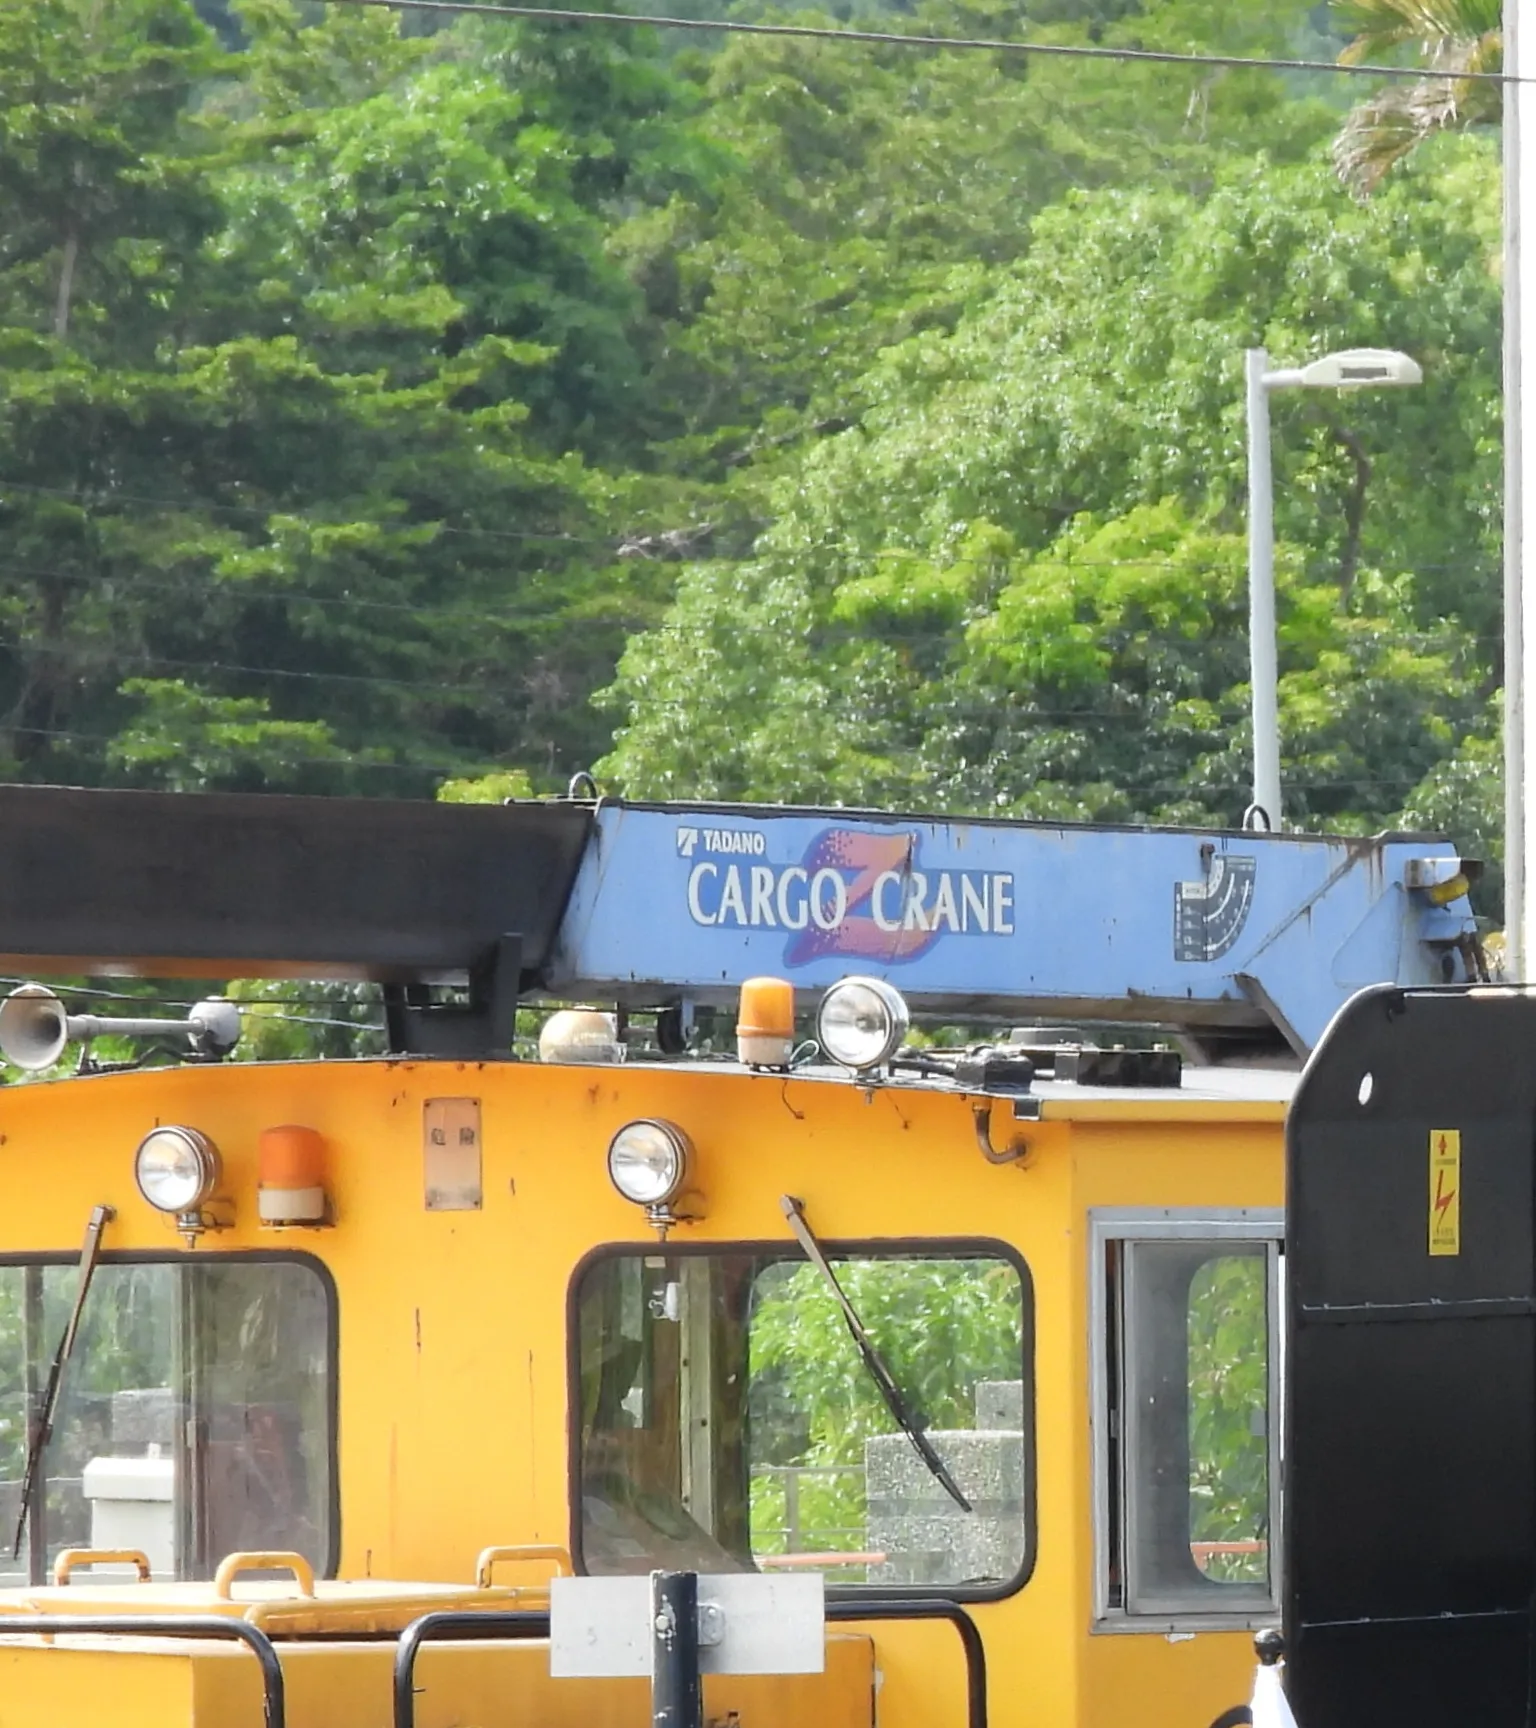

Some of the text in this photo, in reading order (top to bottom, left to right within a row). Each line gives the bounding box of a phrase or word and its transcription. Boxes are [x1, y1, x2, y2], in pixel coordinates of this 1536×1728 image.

[703, 830, 765, 855] TADANO
[688, 862, 1014, 935] CARGO CRANE
